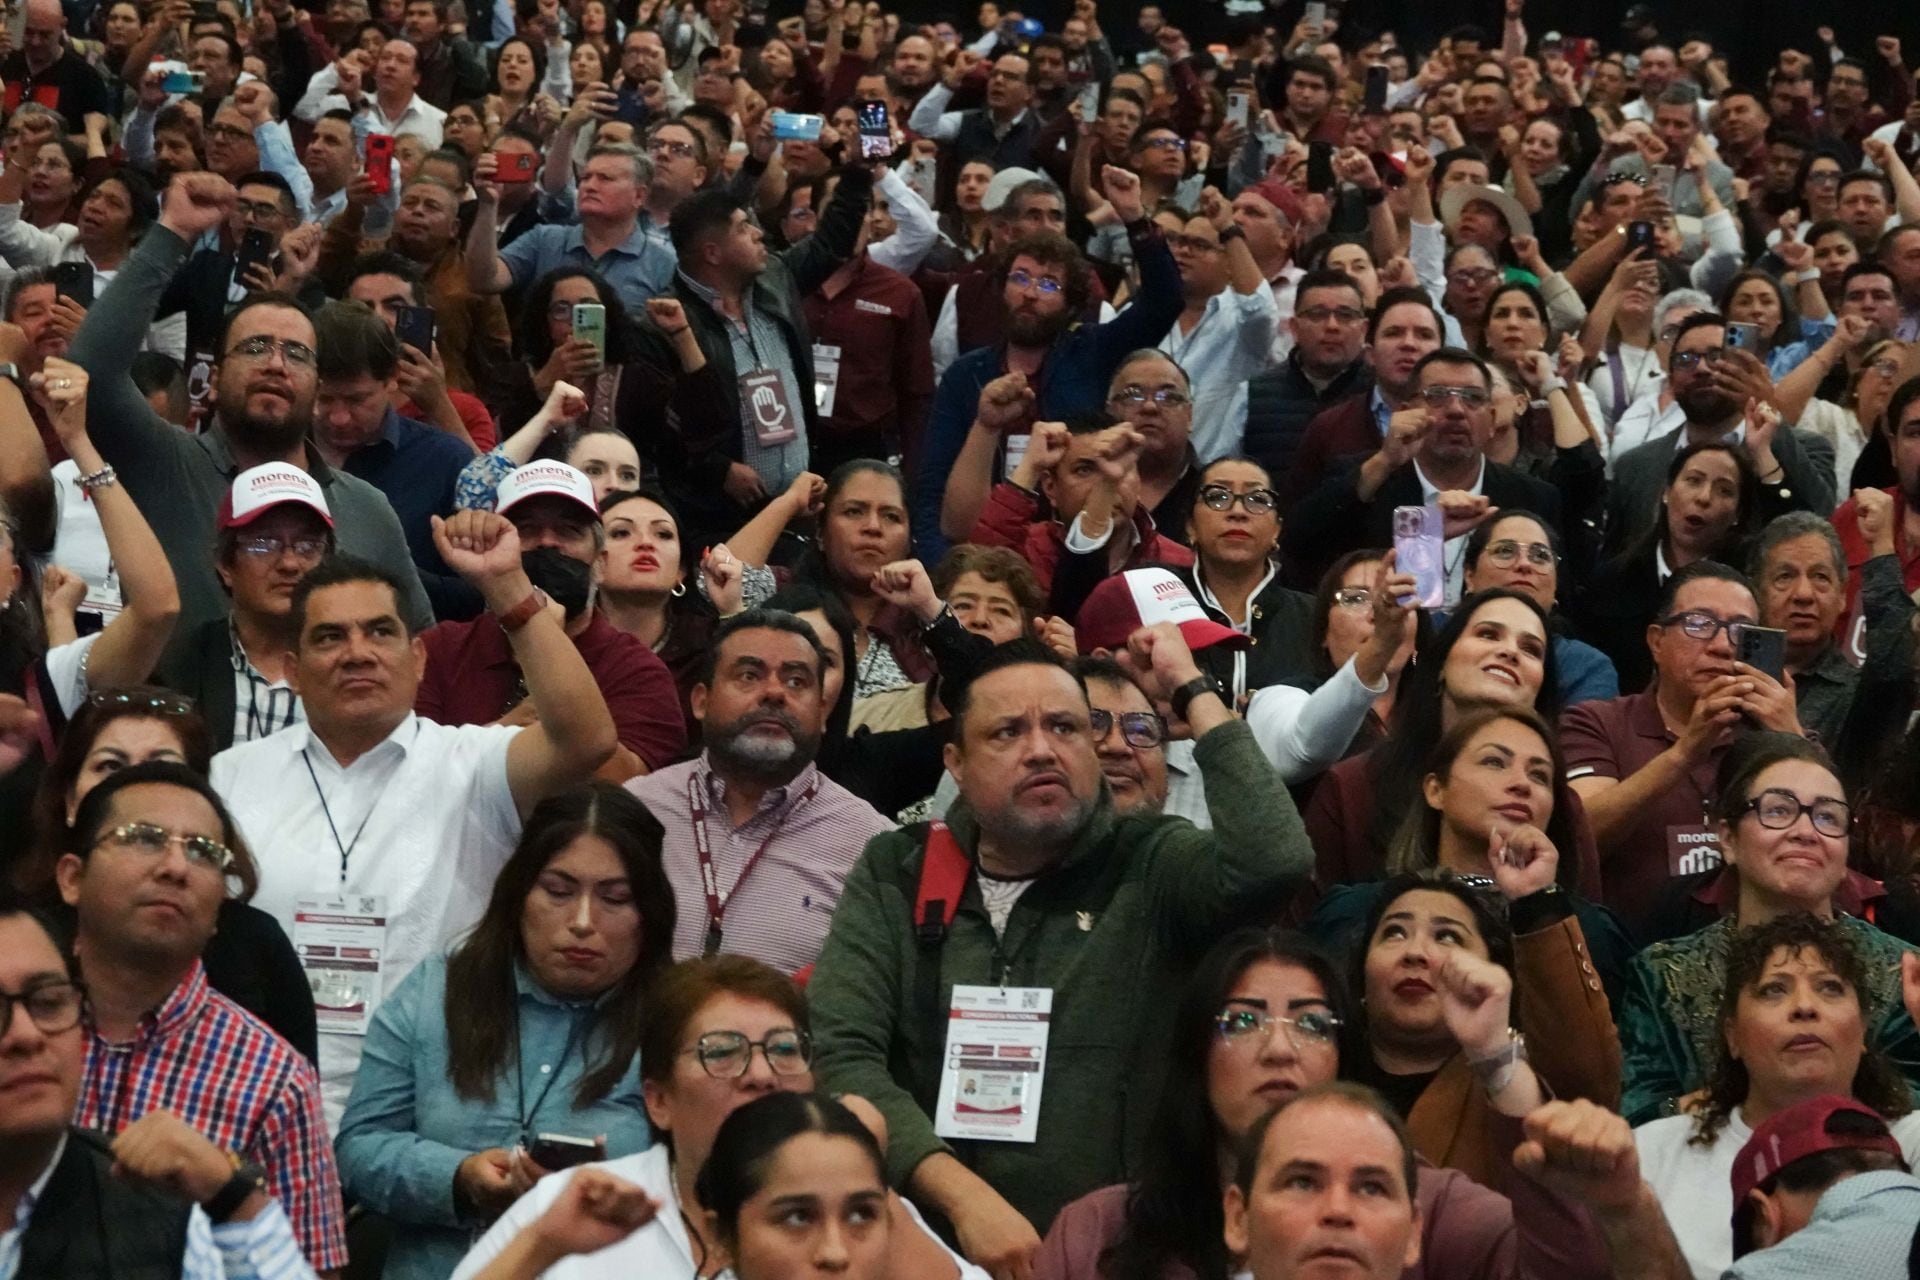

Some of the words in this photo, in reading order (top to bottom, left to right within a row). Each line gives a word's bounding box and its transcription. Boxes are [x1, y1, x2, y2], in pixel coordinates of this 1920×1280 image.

[251, 472, 309, 486] morena
[516, 466, 574, 481] morena
[1153, 580, 1185, 594] more
[1677, 833, 1719, 843] more
